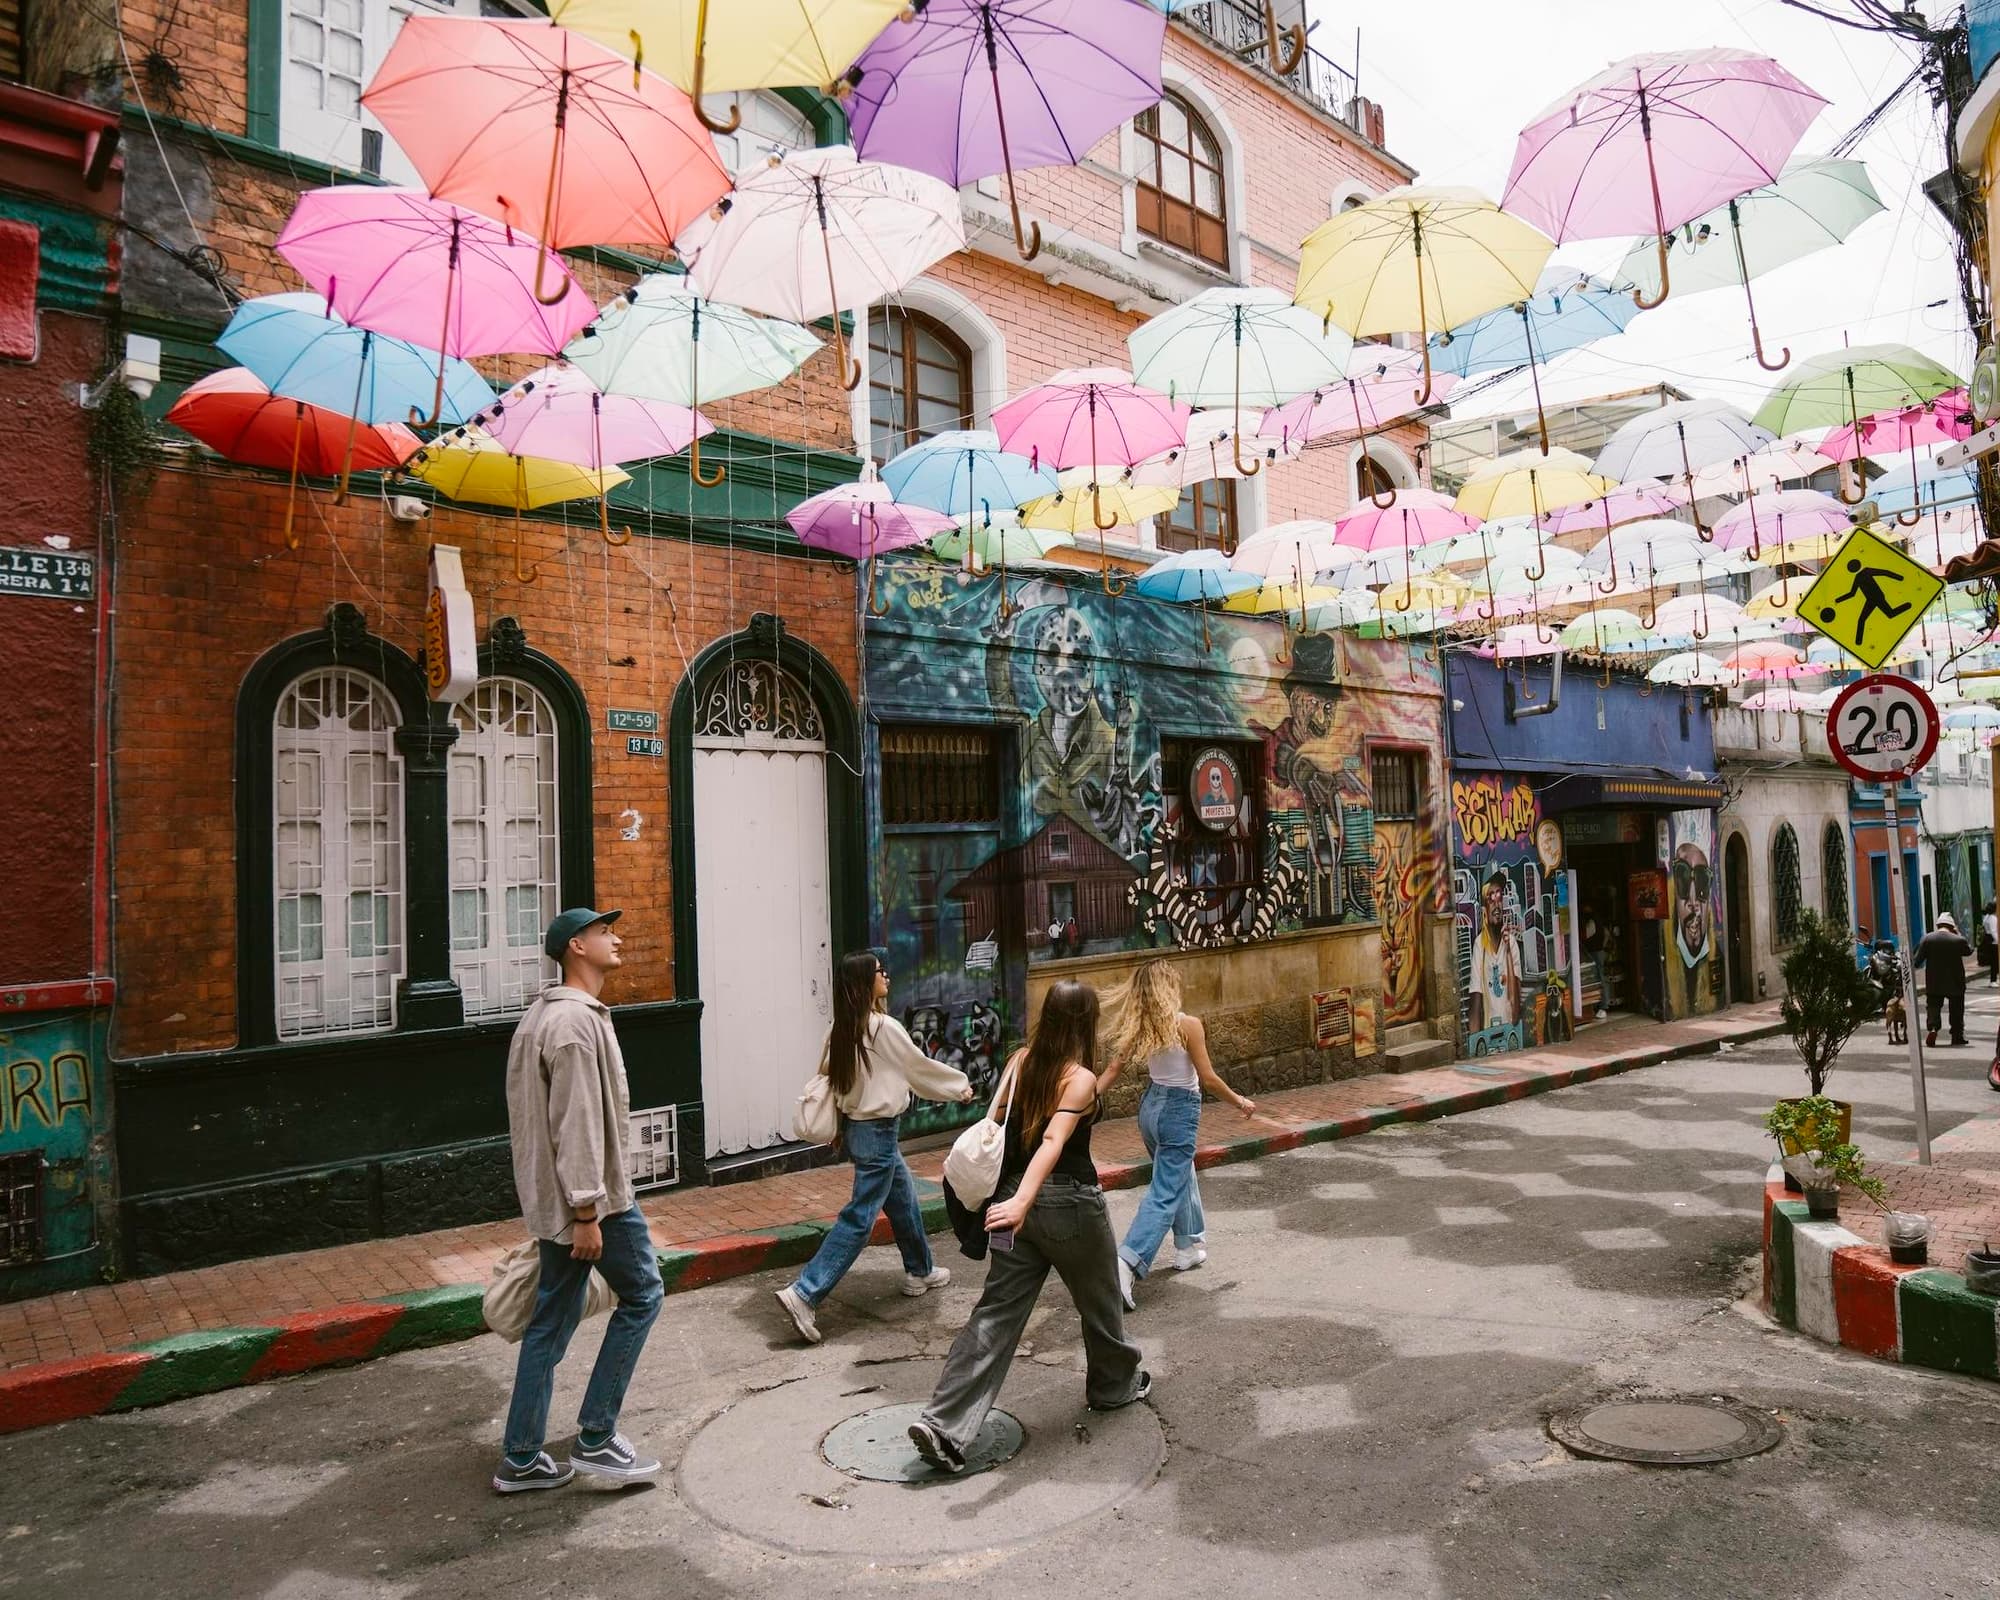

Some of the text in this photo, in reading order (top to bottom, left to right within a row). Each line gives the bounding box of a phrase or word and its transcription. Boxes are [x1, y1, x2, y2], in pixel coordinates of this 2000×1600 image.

[0, 573, 53, 590] RERA
[1848, 701, 1918, 756] 20
[0, 1049, 92, 1133] RA
